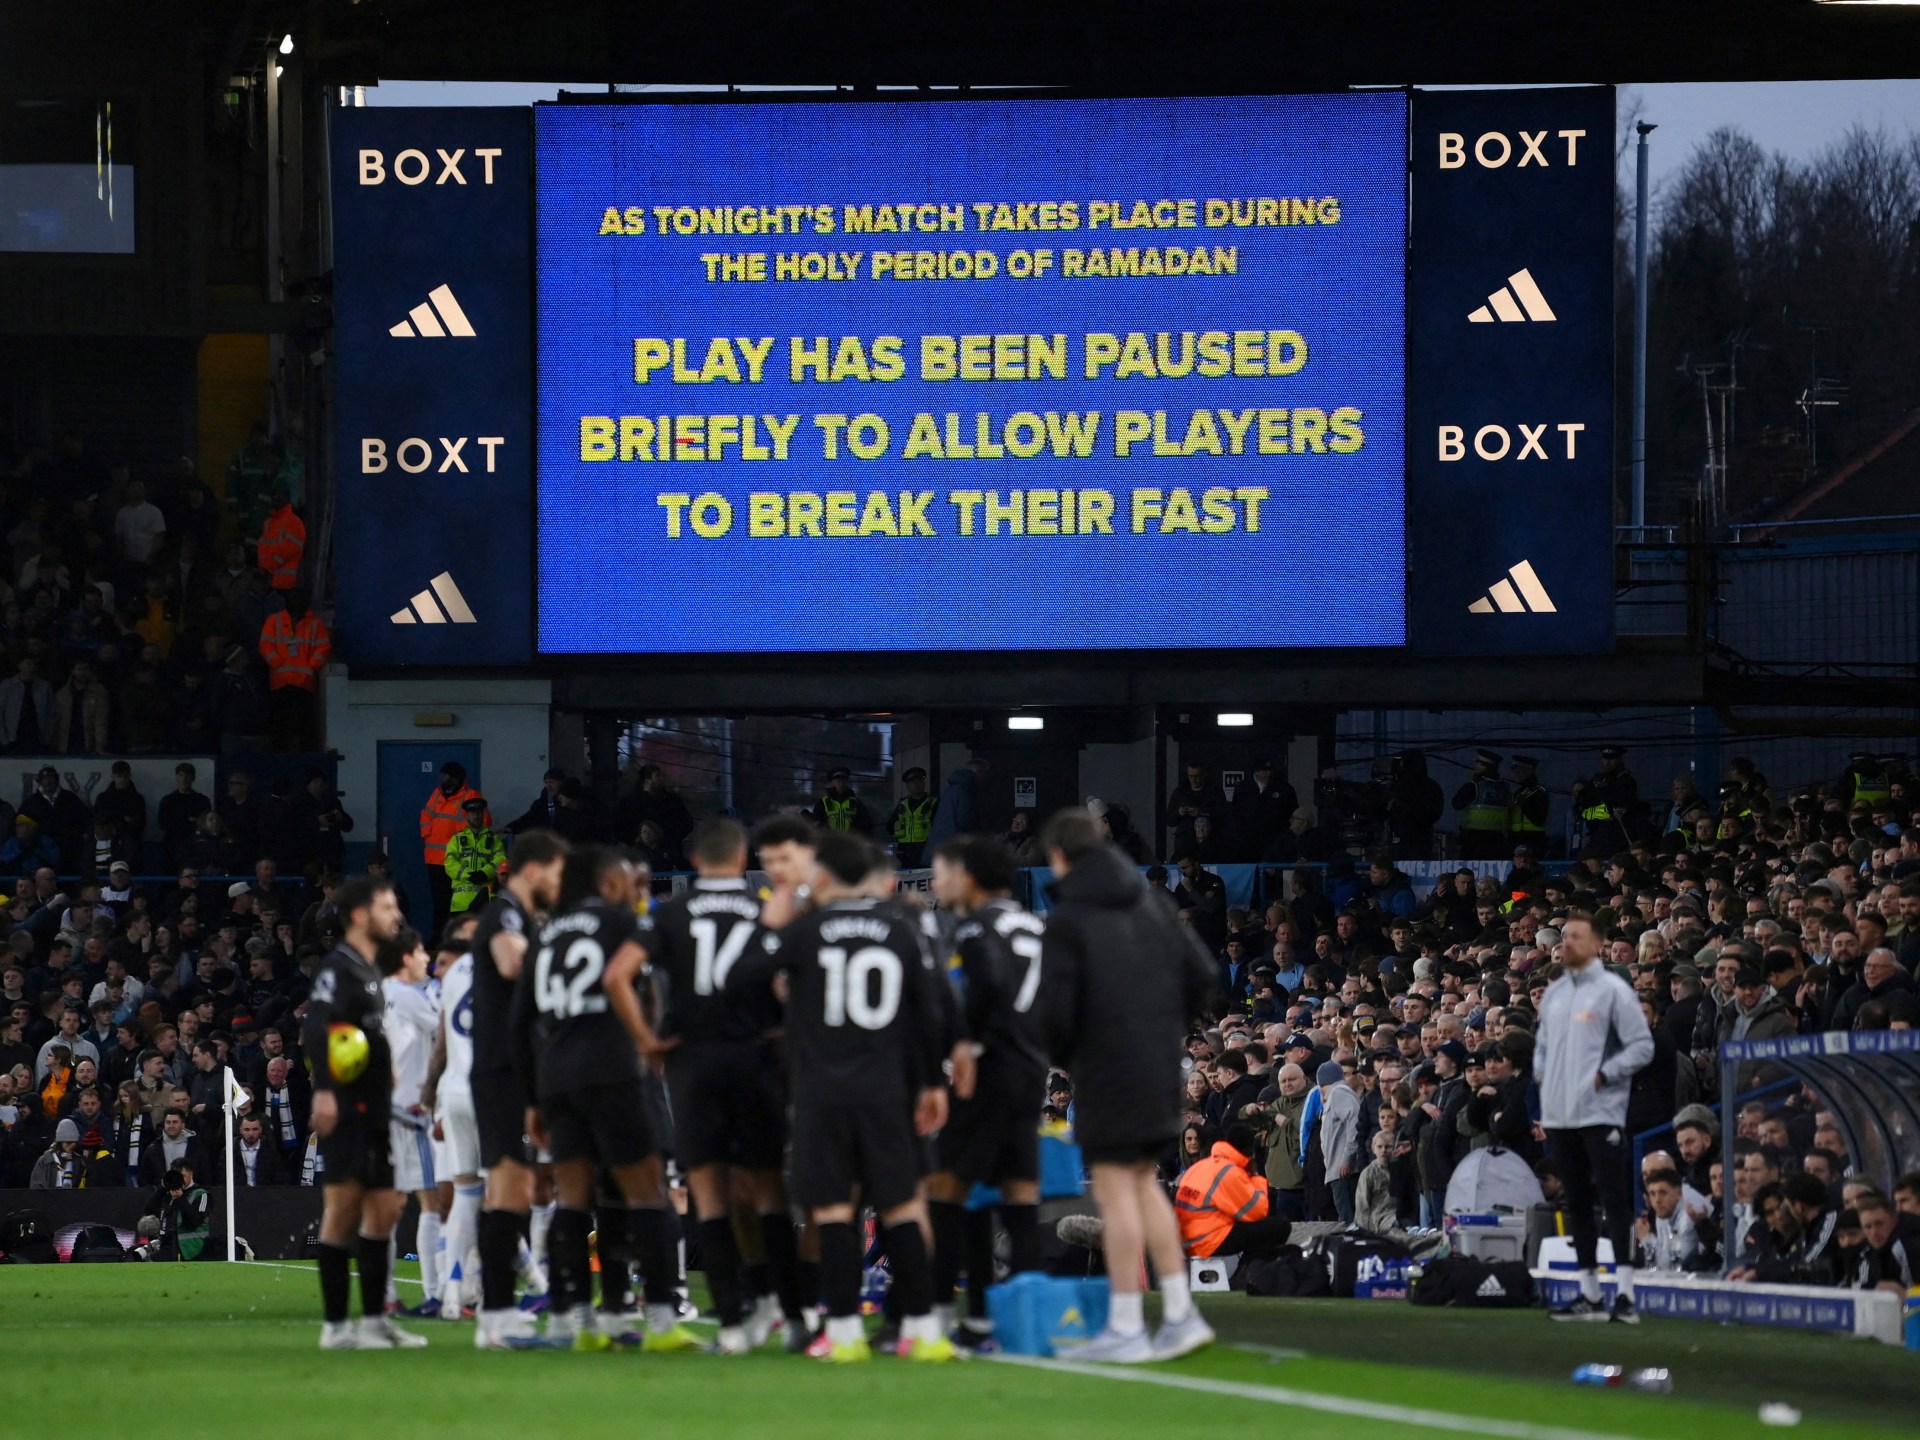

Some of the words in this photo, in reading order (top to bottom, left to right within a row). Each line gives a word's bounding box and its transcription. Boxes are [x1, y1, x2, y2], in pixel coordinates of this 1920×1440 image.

[359, 149, 501, 185] BOXT
[1440, 130, 1585, 168] BOXT
[600, 207, 644, 234] AS
[653, 205, 835, 234] TONIGHT'S
[845, 204, 964, 232] MATCH
[974, 201, 1079, 230] TAKES
[1089, 200, 1196, 228] PLACE
[1206, 196, 1340, 226] DURING
[701, 253, 765, 281] THE
[776, 252, 861, 280] HOLY
[872, 250, 998, 279] PERIOD
[1007, 249, 1052, 277] OF
[1064, 247, 1236, 276] RAMADAN
[635, 337, 773, 381] PLAY
[791, 336, 905, 380] HAS
[921, 334, 1066, 379] BEEN
[1086, 330, 1307, 377] PAUSED
[362, 437, 504, 473] BOXT
[581, 415, 798, 461] BRIEFLY
[815, 414, 889, 459] TO
[904, 411, 1099, 458] ALLOW
[1116, 407, 1363, 455] PLAYERS
[1439, 424, 1584, 461] BOXT
[657, 492, 731, 537] TO
[750, 491, 935, 536] BREAK
[950, 489, 1114, 535] THEIR
[1133, 487, 1267, 532] FAST
[534, 938, 607, 1018] 42
[819, 946, 903, 1030] 10
[1011, 936, 1043, 1013] 7
